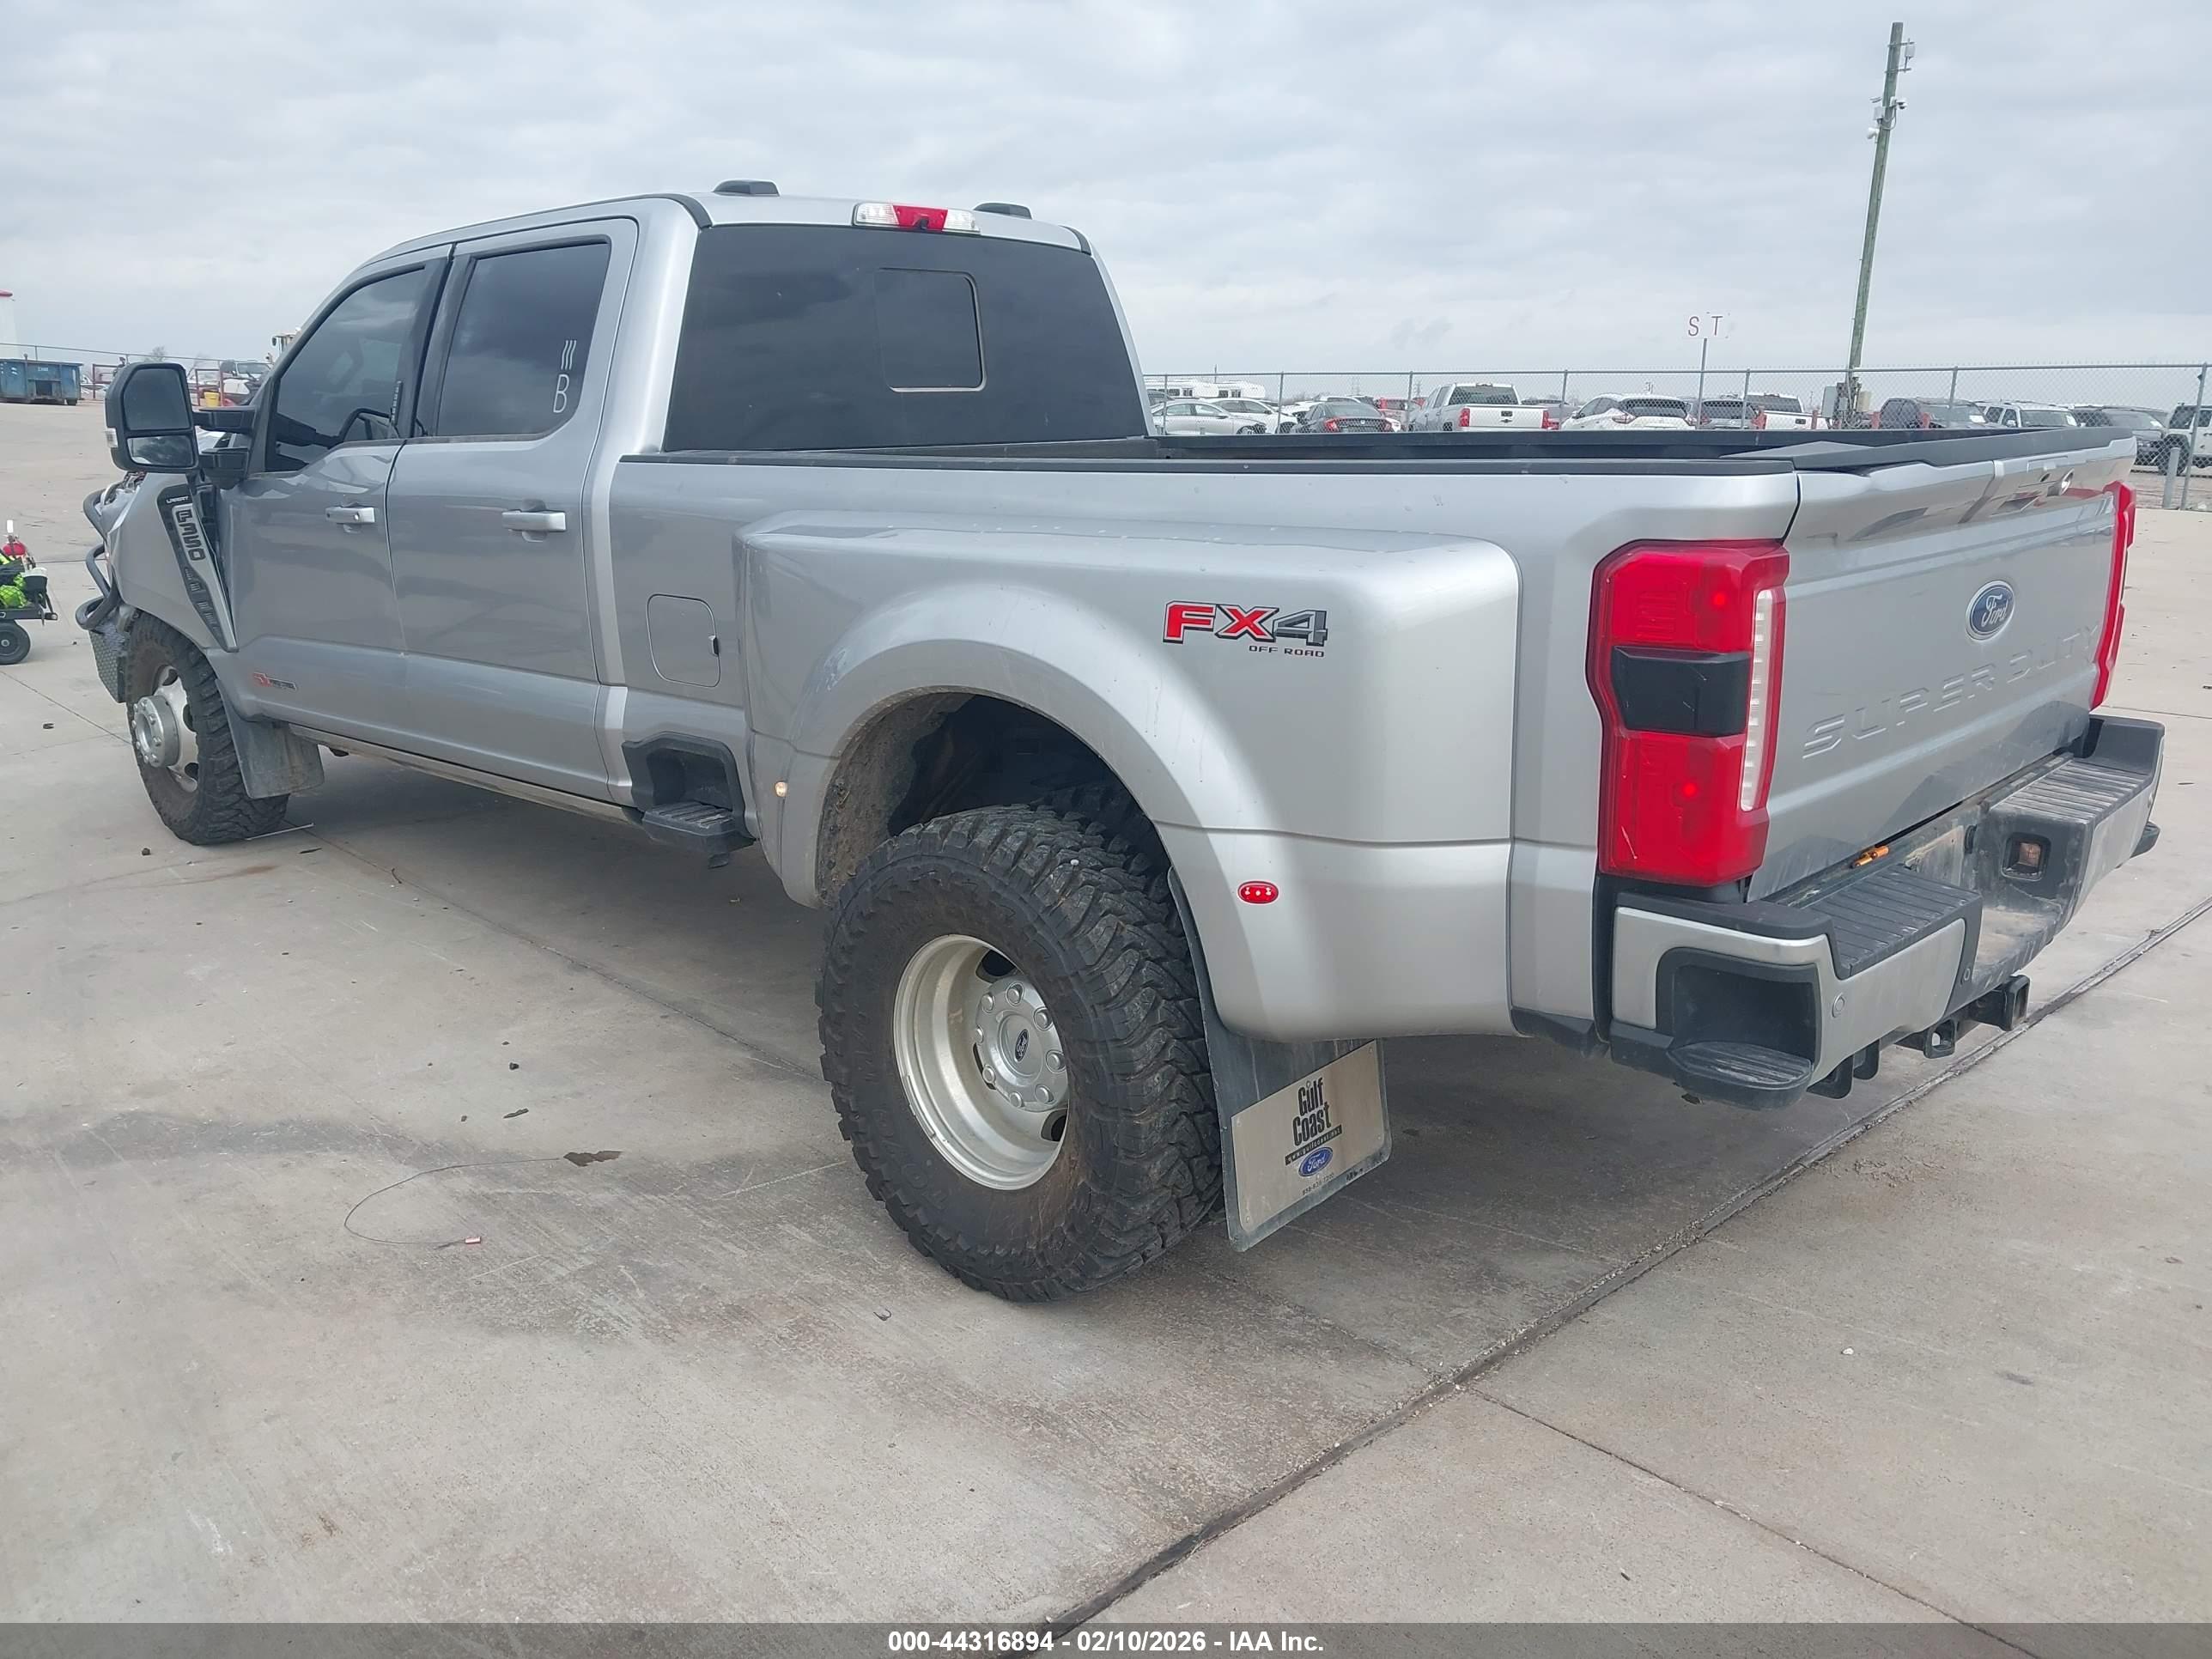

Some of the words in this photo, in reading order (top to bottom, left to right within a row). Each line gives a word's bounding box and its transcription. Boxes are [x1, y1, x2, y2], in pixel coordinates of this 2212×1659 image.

[1163, 600, 1328, 647] FX4
[1249, 645, 1278, 653] OFF
[1285, 647, 1325, 658] ROAD
[1802, 663, 1996, 759] SUPER
[2007, 624, 2098, 684] DUTY
[1298, 1078, 1323, 1116] Gulf
[1293, 1102, 1331, 1146] Coast
